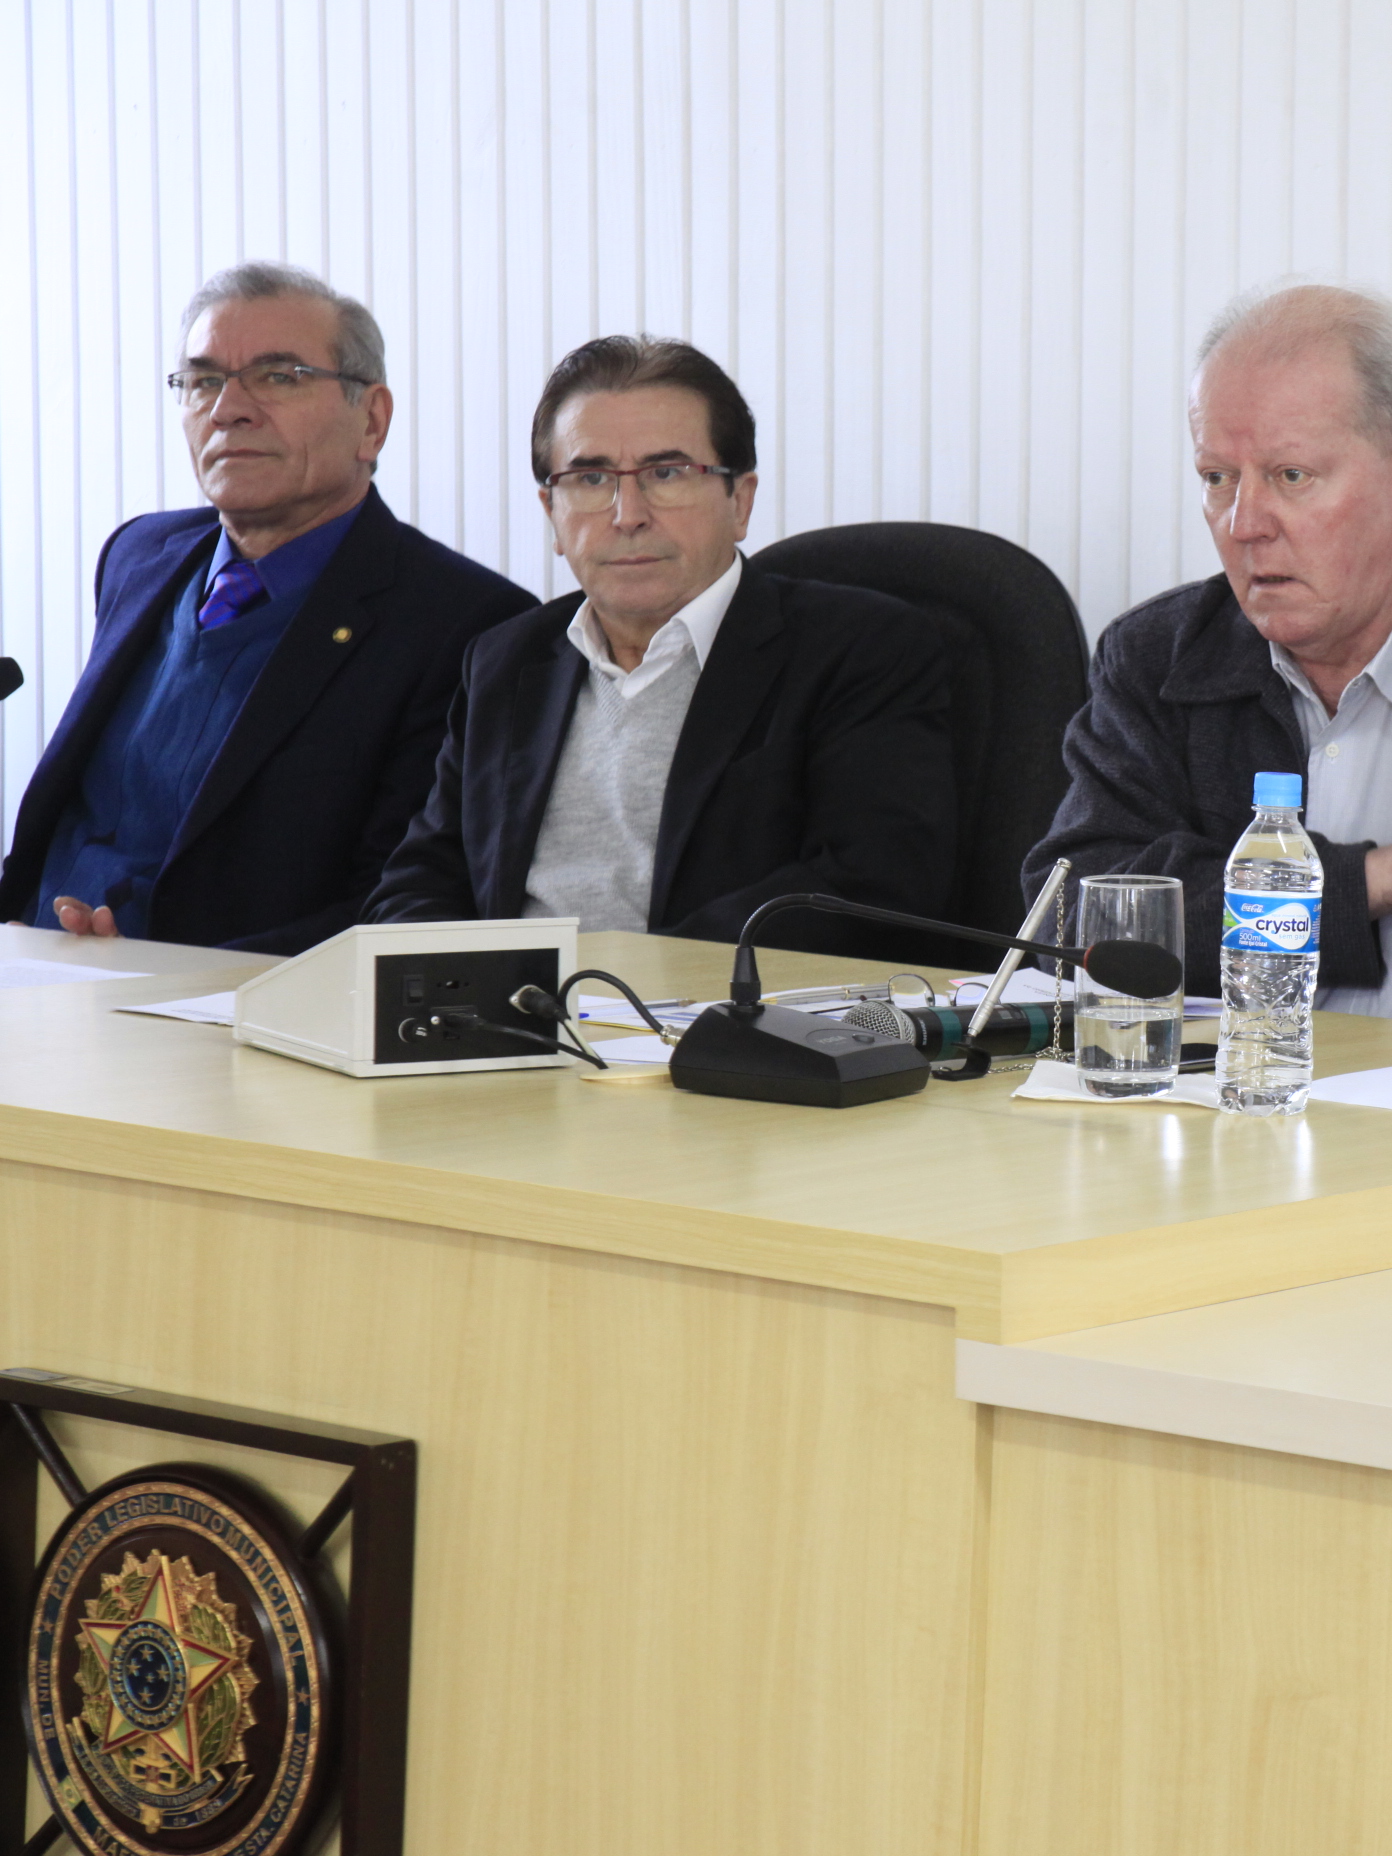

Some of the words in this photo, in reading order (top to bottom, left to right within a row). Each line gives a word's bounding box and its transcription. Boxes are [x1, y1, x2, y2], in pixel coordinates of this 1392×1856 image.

[1239, 932, 1261, 941] 500ml
[1255, 917, 1309, 934] crystal
[50, 1521, 104, 1601] PODER
[105, 1494, 225, 1534] LEGISLATIVO
[224, 1531, 305, 1668] MUNICIPAL
[37, 1658, 51, 1710] MUN.
[40, 1713, 56, 1739] DE
[270, 1732, 309, 1823] CATARINA
